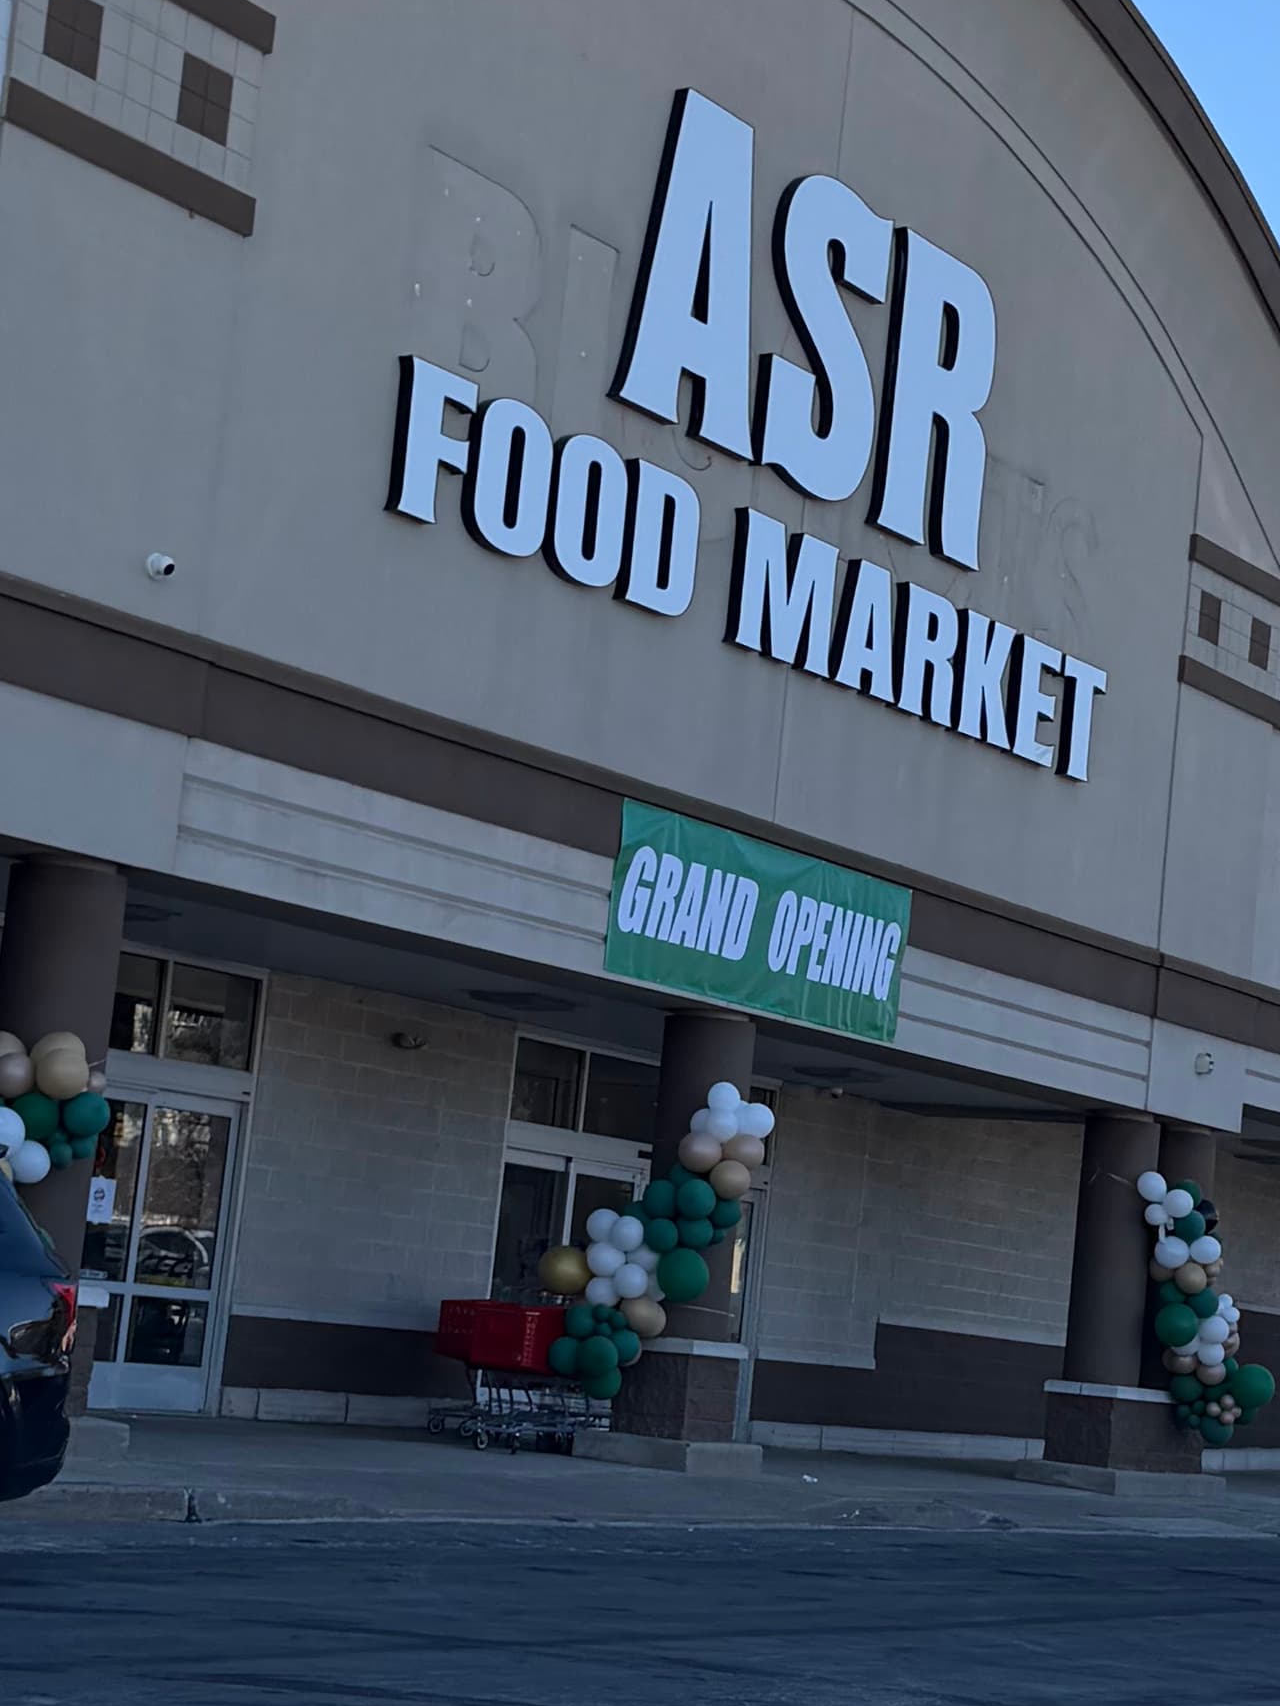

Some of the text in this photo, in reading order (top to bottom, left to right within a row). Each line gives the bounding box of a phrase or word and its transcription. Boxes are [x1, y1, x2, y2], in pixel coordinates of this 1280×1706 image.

[608, 87, 998, 572] ASR
[384, 355, 701, 617] FOOD
[724, 506, 1108, 782] MARKET
[617, 845, 902, 1001] GRAND OPENING
